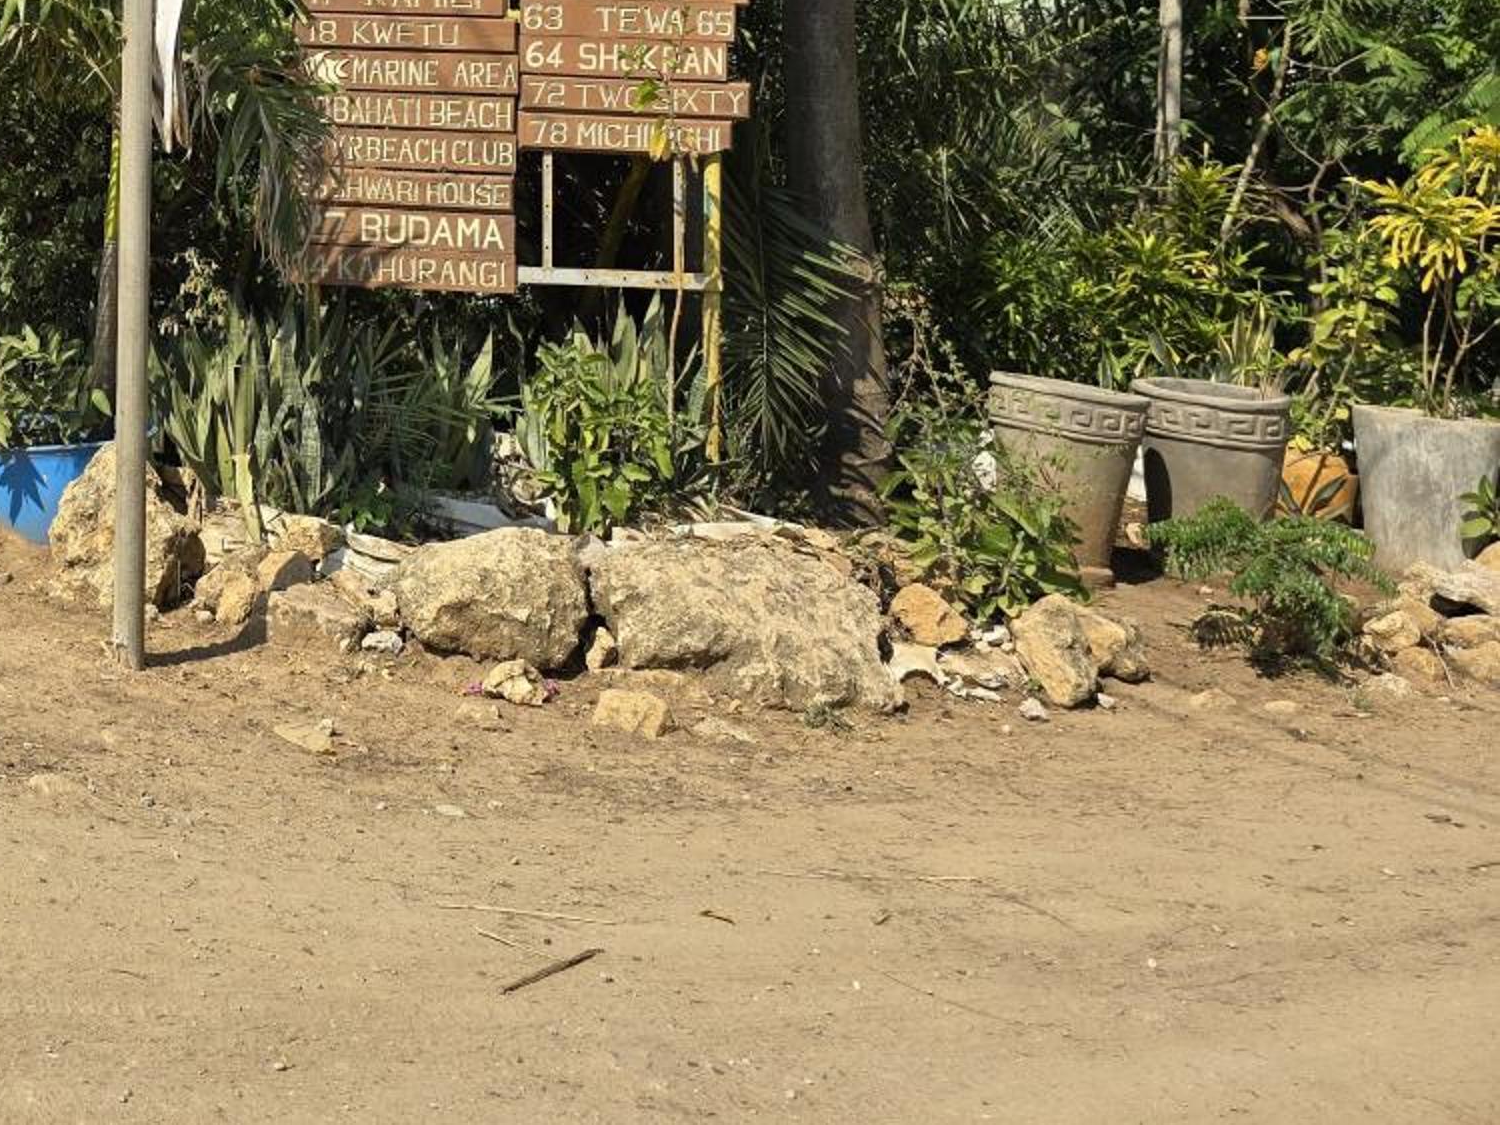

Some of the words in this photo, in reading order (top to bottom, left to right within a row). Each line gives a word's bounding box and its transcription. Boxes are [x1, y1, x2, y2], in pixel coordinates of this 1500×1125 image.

[309, 20, 337, 43] 18
[352, 22, 459, 46] KWETU
[523, 5, 563, 30] 63
[596, 6, 684, 35] TEWA
[696, 10, 734, 36] 65
[525, 41, 564, 68] 64
[351, 59, 439, 86] MARINE
[453, 61, 517, 89] AREA
[528, 82, 565, 106] 72
[333, 96, 421, 125] BAHATI
[429, 100, 512, 129] BEACH
[529, 121, 567, 145] 78
[367, 138, 446, 164] BEACH
[451, 141, 514, 166] CLUB
[426, 182, 510, 206] HOUSE
[361, 214, 504, 250] BUDAMA
[339, 254, 505, 287] KAHURANGI
